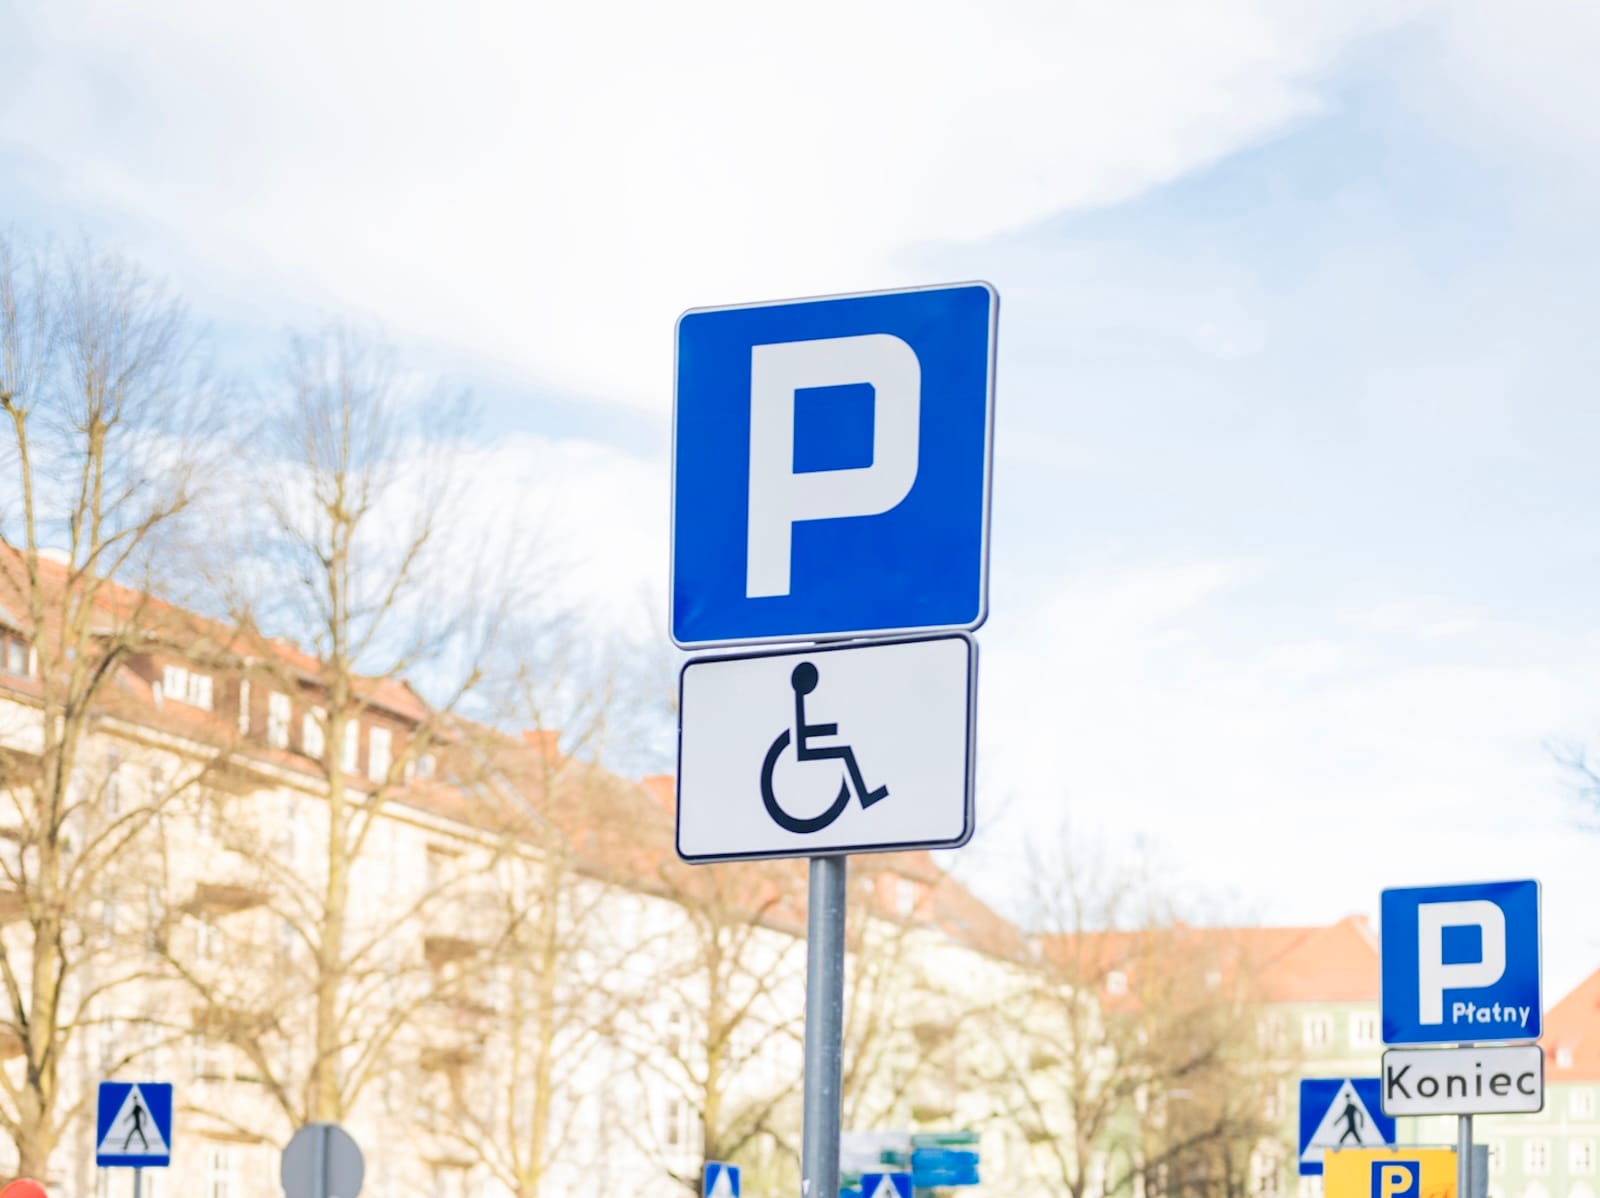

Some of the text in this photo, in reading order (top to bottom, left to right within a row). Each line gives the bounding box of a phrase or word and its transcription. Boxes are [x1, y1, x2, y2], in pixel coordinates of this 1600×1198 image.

[745, 333, 922, 599] P
[1418, 900, 1506, 1025] P
[1452, 1001, 1531, 1029] Płatny
[1387, 1062, 1536, 1100] Koniec
